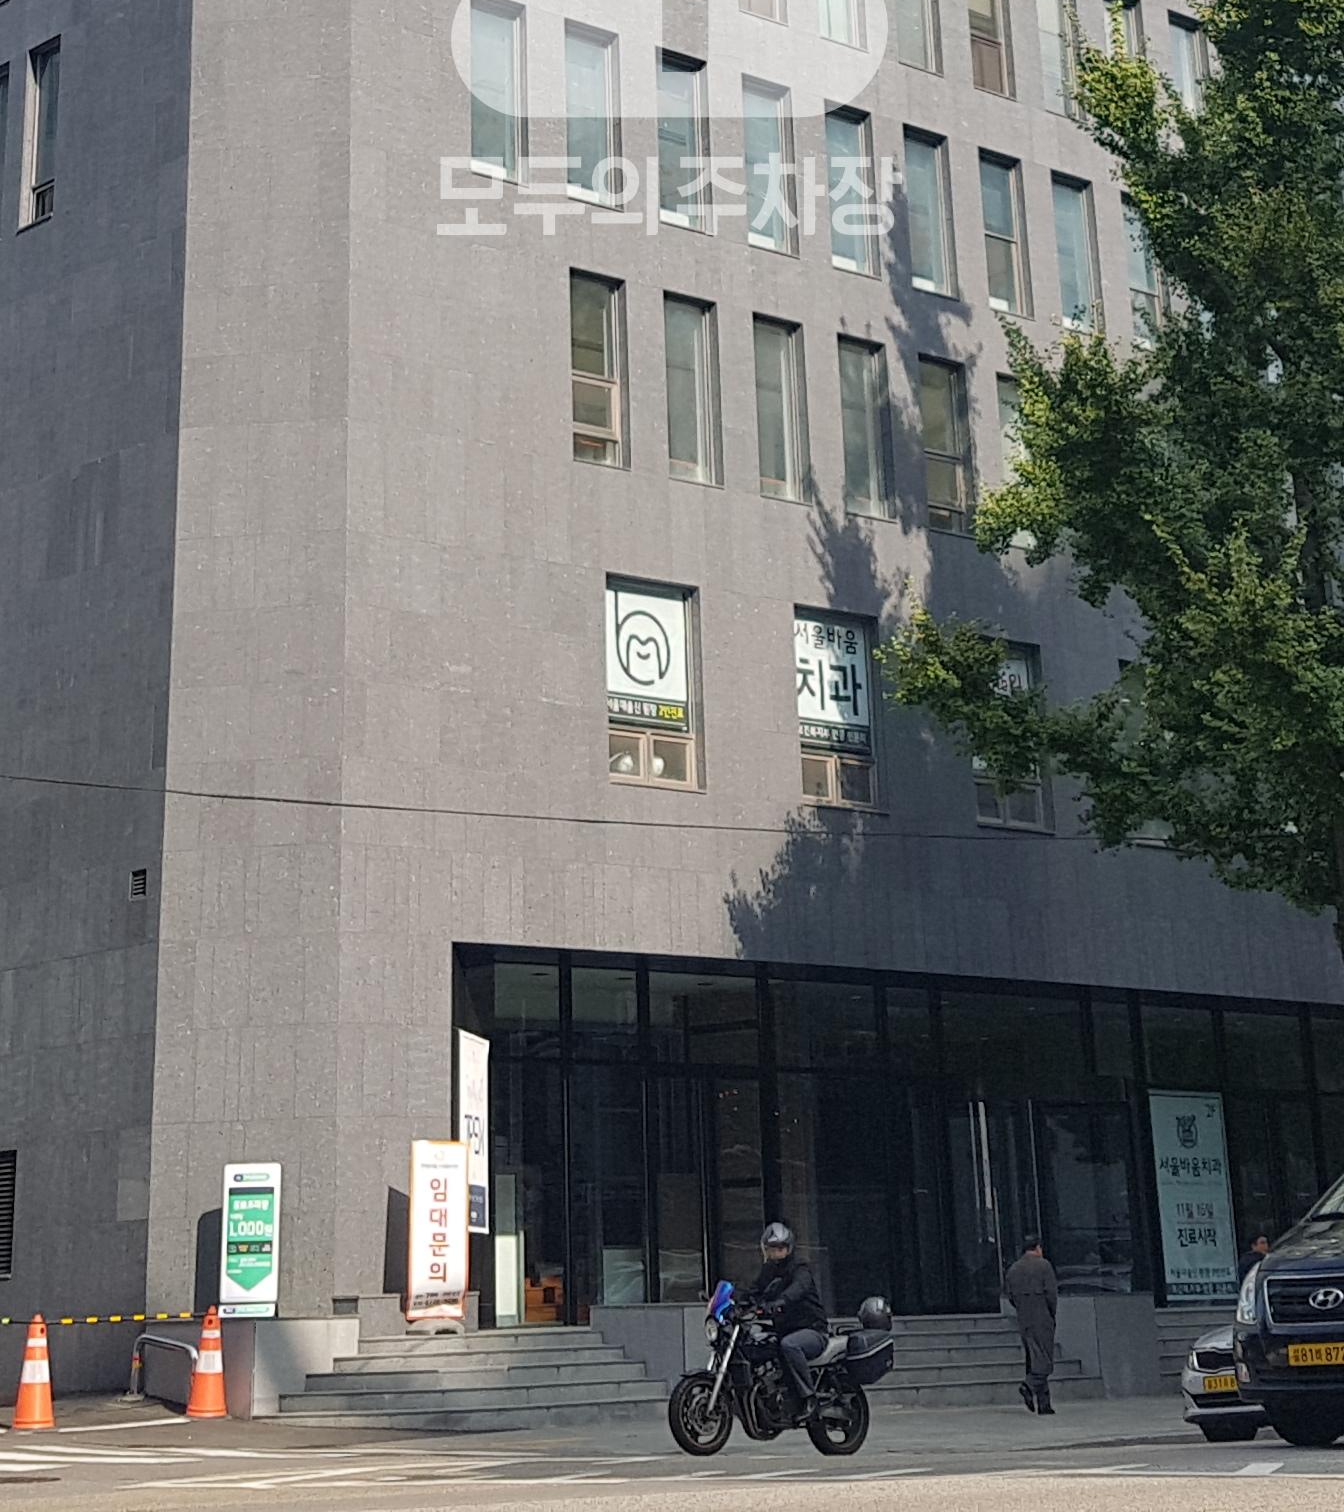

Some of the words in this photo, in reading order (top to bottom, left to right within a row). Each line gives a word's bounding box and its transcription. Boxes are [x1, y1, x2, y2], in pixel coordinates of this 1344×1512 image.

[796, 656, 862, 717] 치과
[1159, 1156, 1223, 1178] 서울바움치과
[429, 1177, 450, 1283] 임대문의
[1177, 1228, 1217, 1248] 진료시작
